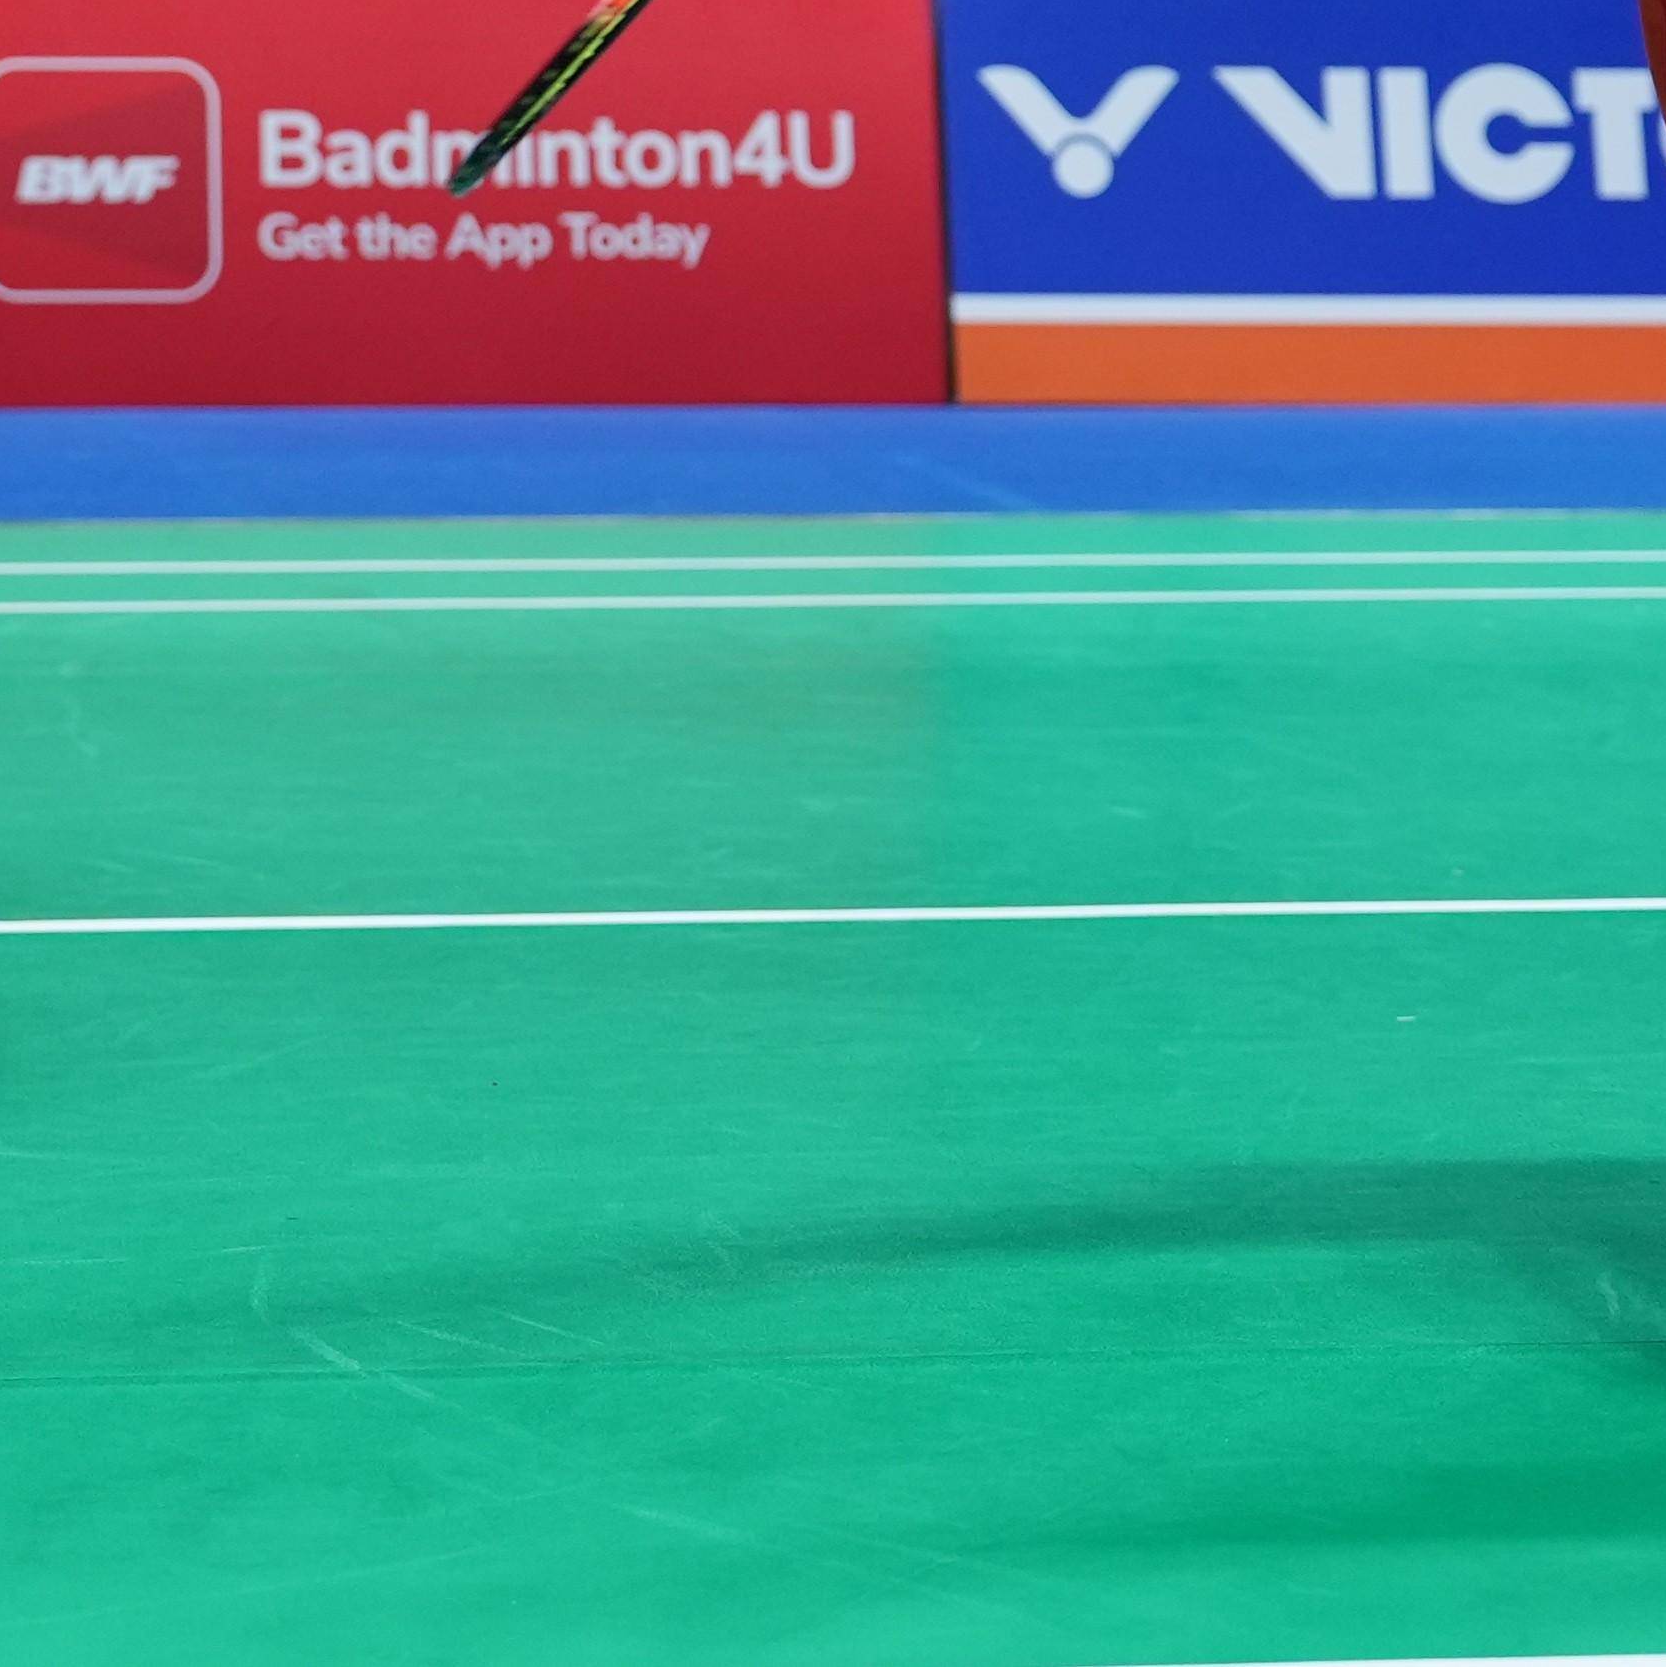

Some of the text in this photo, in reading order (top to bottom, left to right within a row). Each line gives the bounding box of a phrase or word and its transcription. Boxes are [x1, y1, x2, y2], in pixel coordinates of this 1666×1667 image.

[16, 155, 180, 205] BWF
[258, 211, 709, 269] Get the App Today
